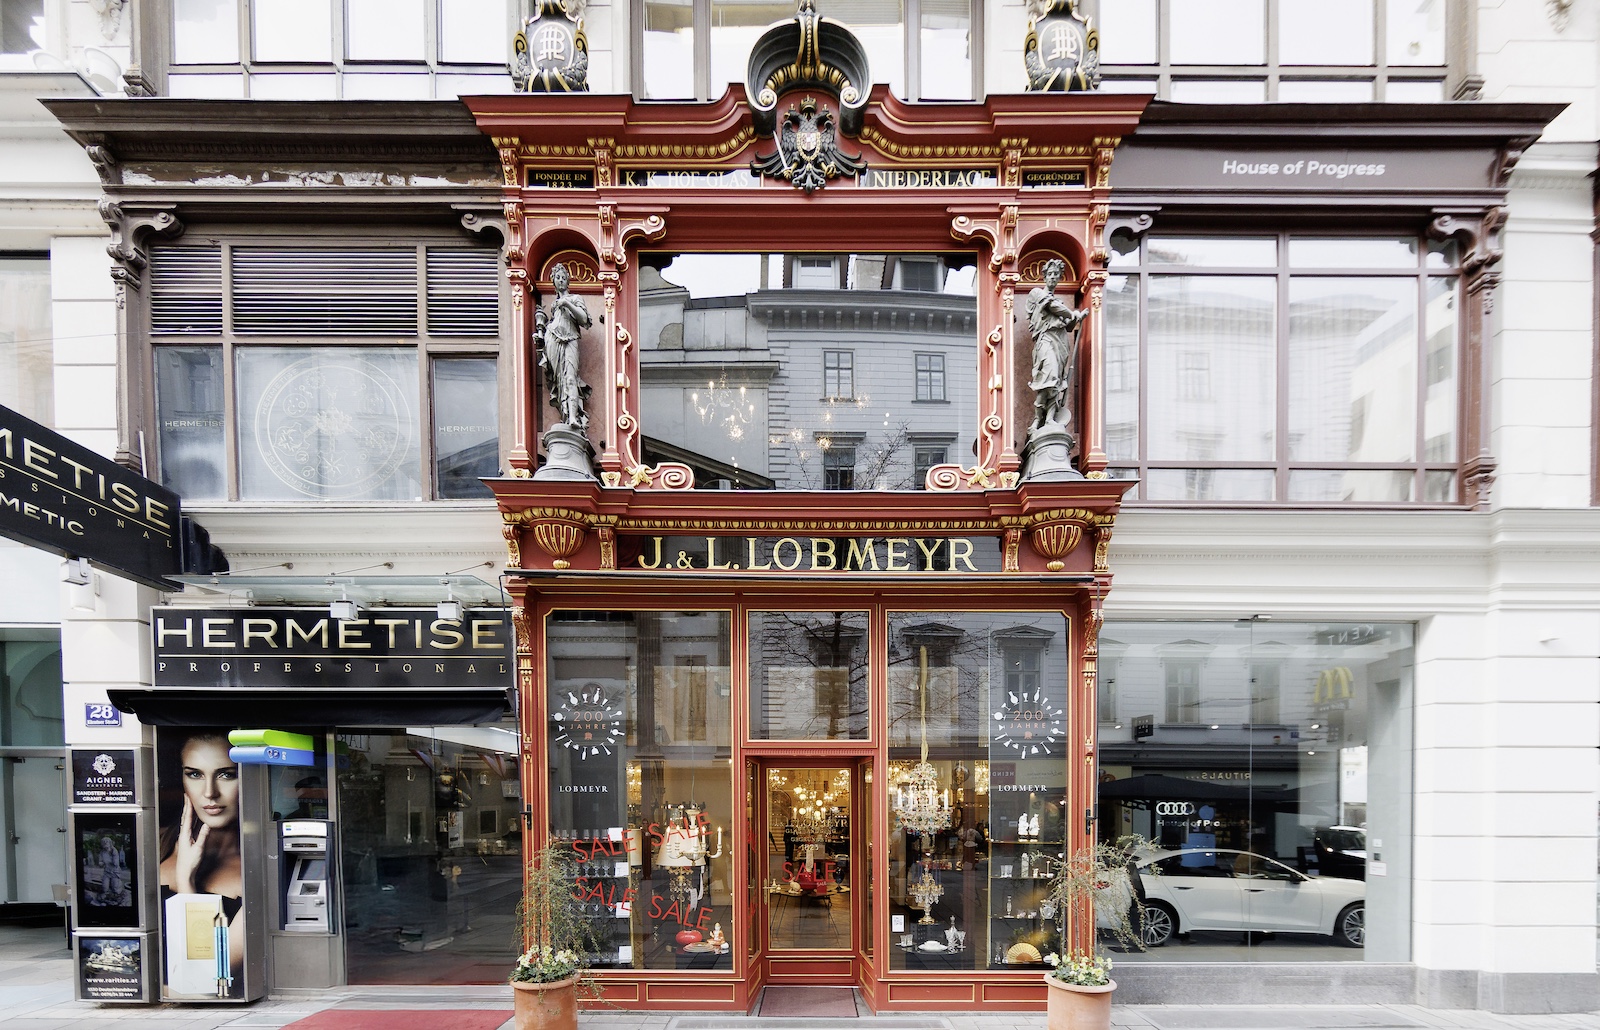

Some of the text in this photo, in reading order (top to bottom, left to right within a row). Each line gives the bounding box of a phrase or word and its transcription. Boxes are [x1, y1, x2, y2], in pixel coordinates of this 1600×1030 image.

[574, 173, 587, 181] EN
[1027, 173, 1081, 181] GEGRÜNDET
[1222, 160, 1386, 179] House of Progress
[625, 171, 640, 187] K.
[667, 171, 749, 187] HOF-GLAS
[637, 537, 979, 572] J. & L. LOBMEYR
[157, 617, 505, 651] HERMETISE
[158, 662, 507, 675] PROFESSIONAL
[90, 704, 114, 719] 28
[573, 711, 604, 723] 200
[1013, 710, 1044, 721] 200
[998, 784, 1048, 792] LOBMEYR
[648, 811, 714, 848] SALE
[571, 829, 637, 864] SALE
[781, 861, 837, 883] SALE
[571, 877, 636, 912] SALE
[647, 894, 714, 932] SALE
